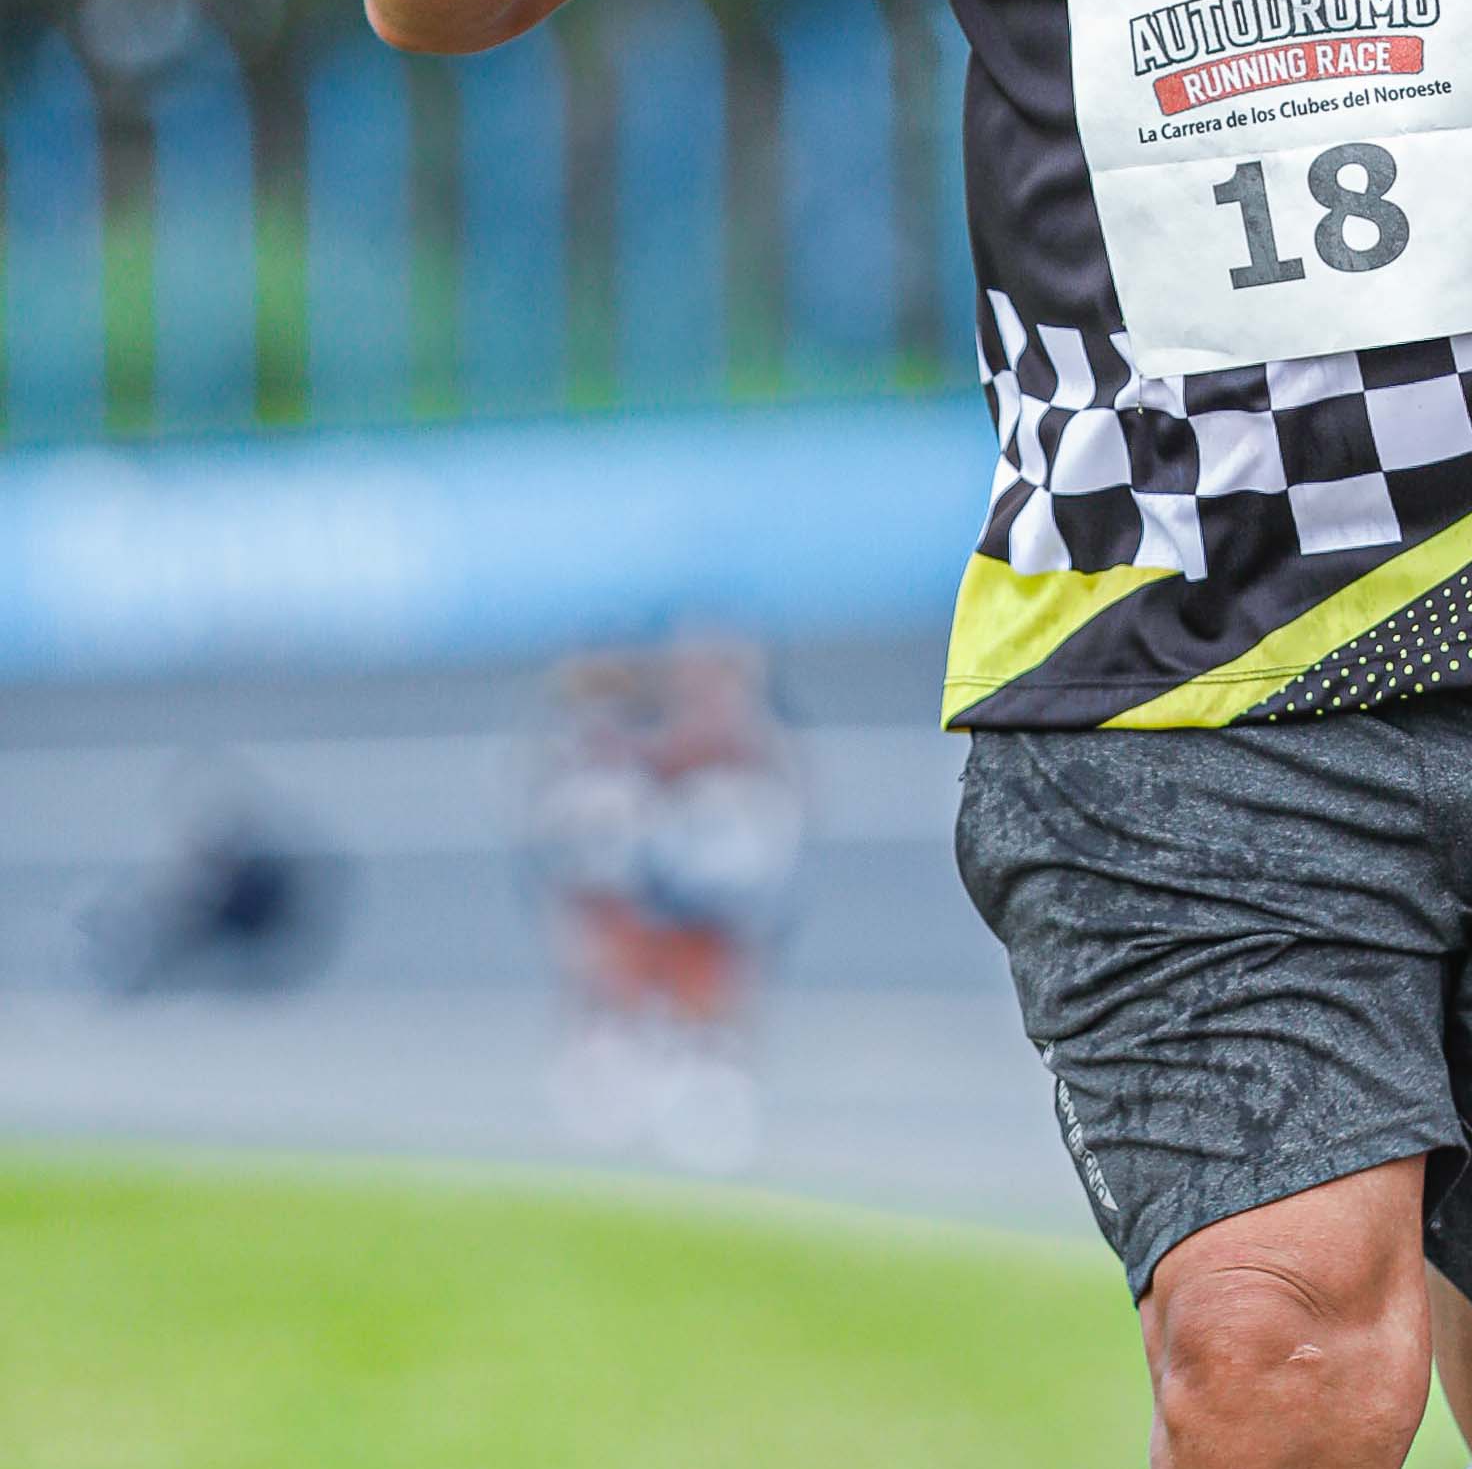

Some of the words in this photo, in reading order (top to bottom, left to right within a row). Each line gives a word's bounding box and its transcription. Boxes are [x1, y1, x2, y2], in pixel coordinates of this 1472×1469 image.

[1183, 48, 1306, 105] RUNNING
[1316, 41, 1392, 76] RACE
[1138, 127, 1157, 144] La
[1161, 117, 1222, 141] Carrera
[1226, 110, 1248, 129] de
[1252, 107, 1276, 125] los
[1280, 100, 1339, 119] Clubes
[1343, 88, 1371, 108] del
[1374, 79, 1453, 103] Noroeste
[1213, 142, 1410, 290] 18
